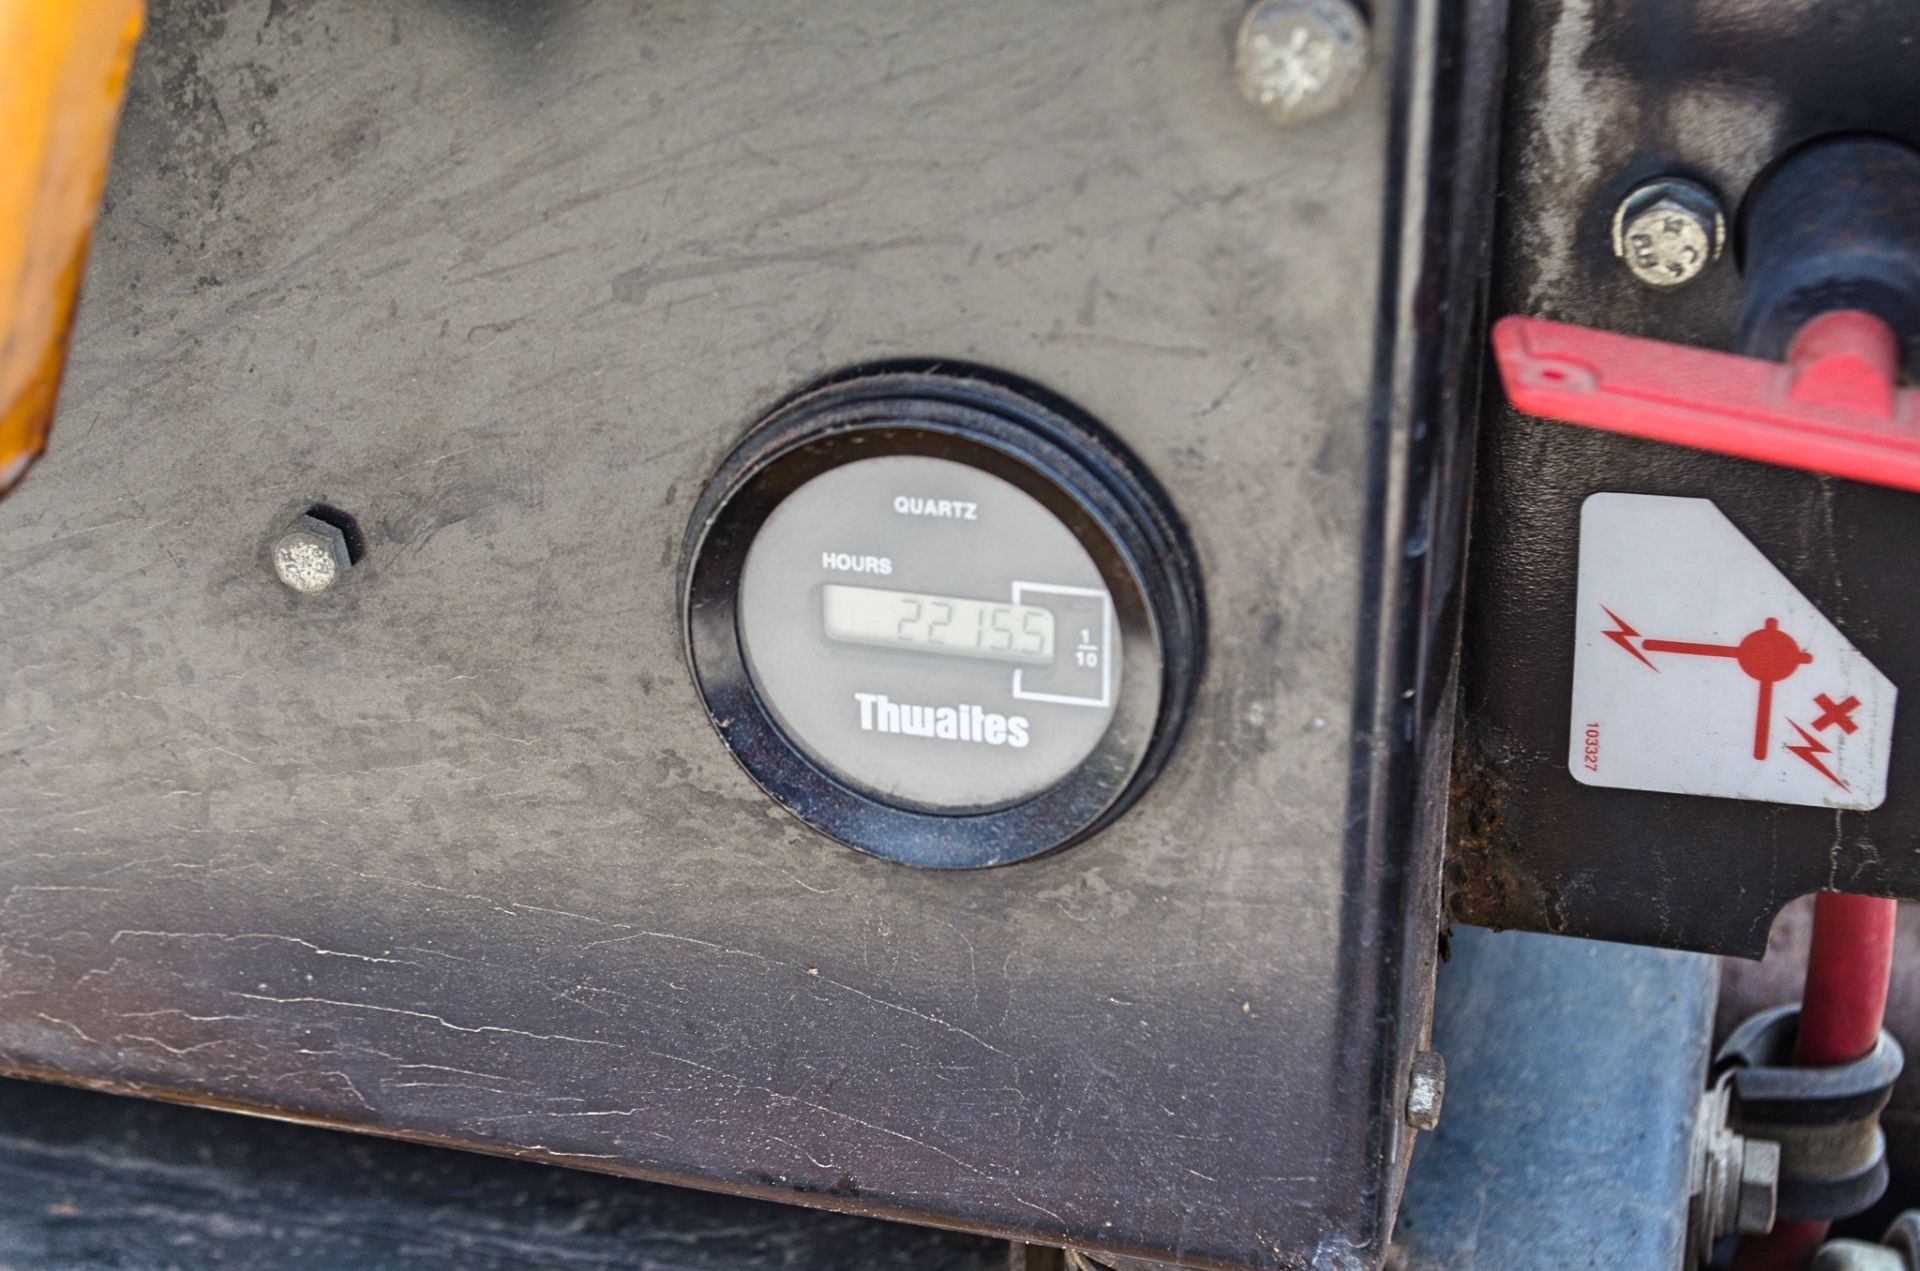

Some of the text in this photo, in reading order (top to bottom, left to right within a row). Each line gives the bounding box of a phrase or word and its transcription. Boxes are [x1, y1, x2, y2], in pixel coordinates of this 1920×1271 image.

[894, 496, 978, 520] QUARTZ
[822, 552, 893, 575] HOURS
[854, 693, 1030, 748] Thwaites
[1585, 722, 1600, 771] 103327
